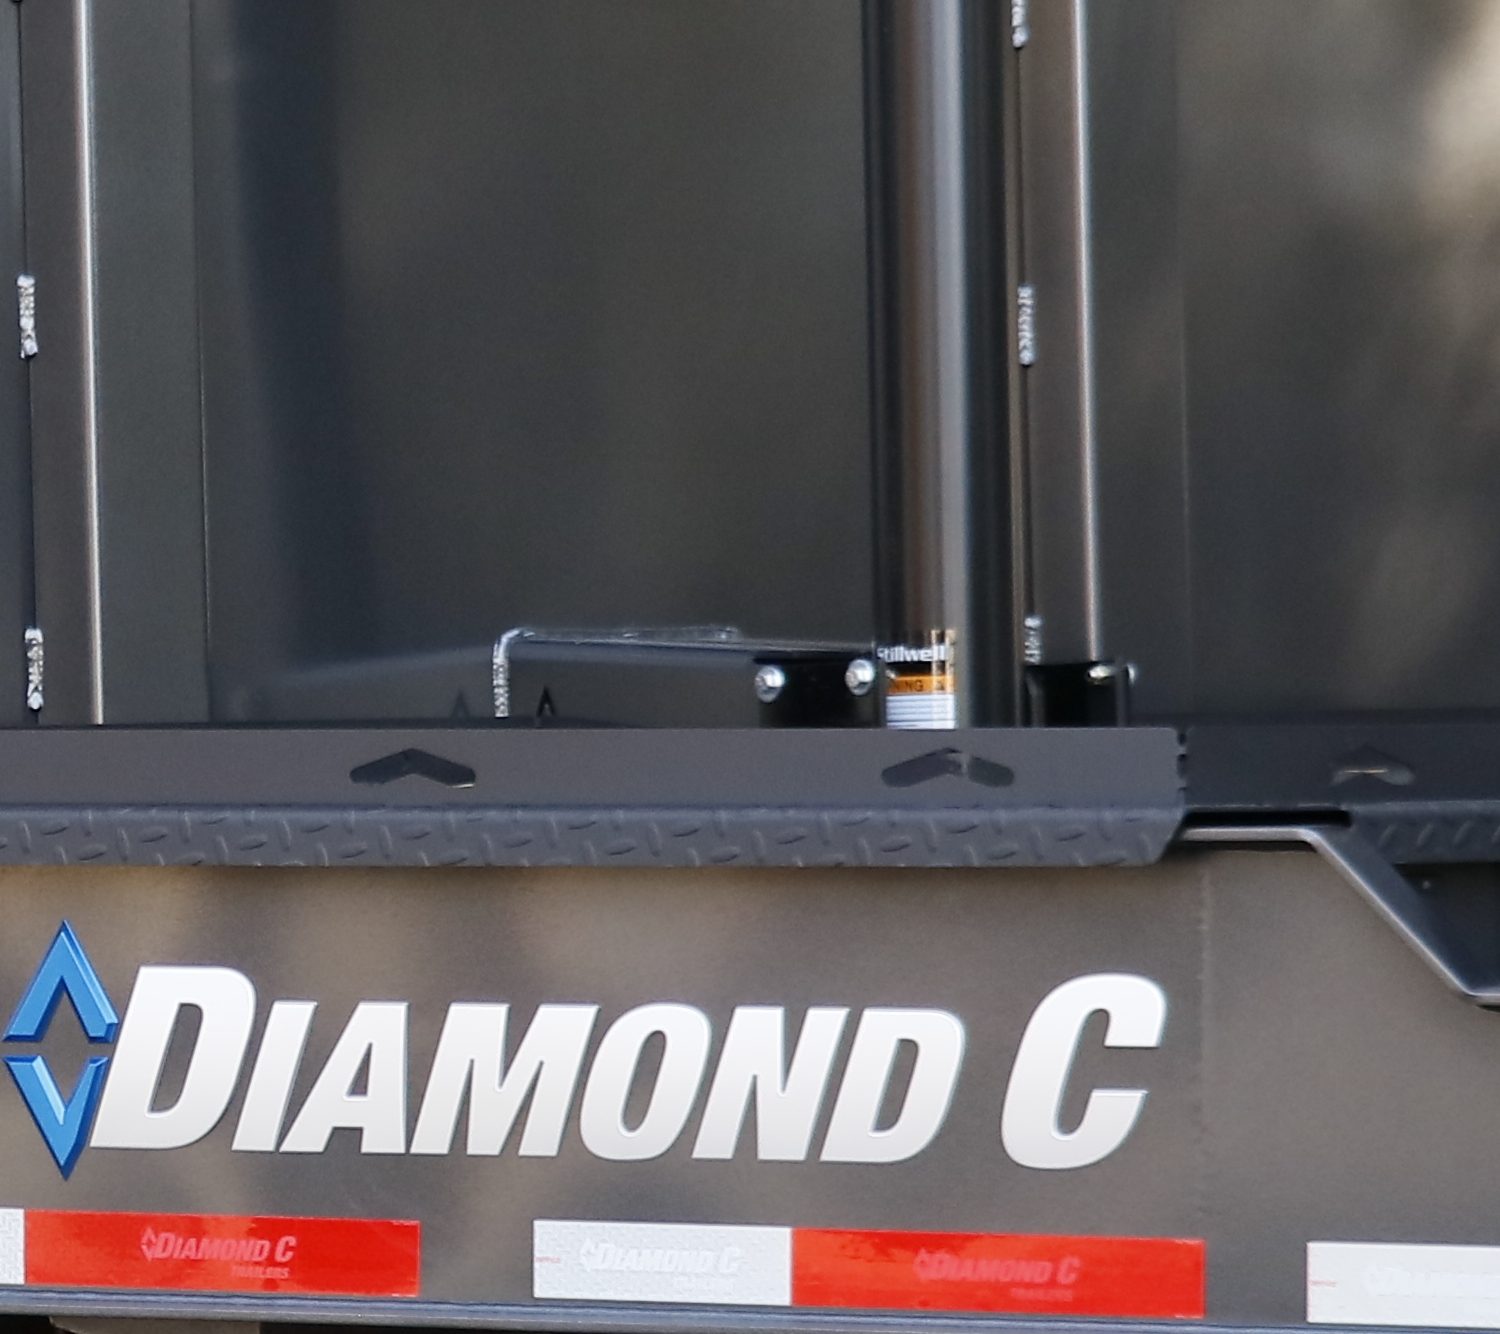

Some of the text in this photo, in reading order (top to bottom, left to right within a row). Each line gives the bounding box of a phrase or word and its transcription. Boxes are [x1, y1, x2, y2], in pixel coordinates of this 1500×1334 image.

[89, 965, 1167, 1169] DIAMOND C
[153, 1231, 297, 1263] DIAMOND C
[1055, 1256, 1080, 1285] C
